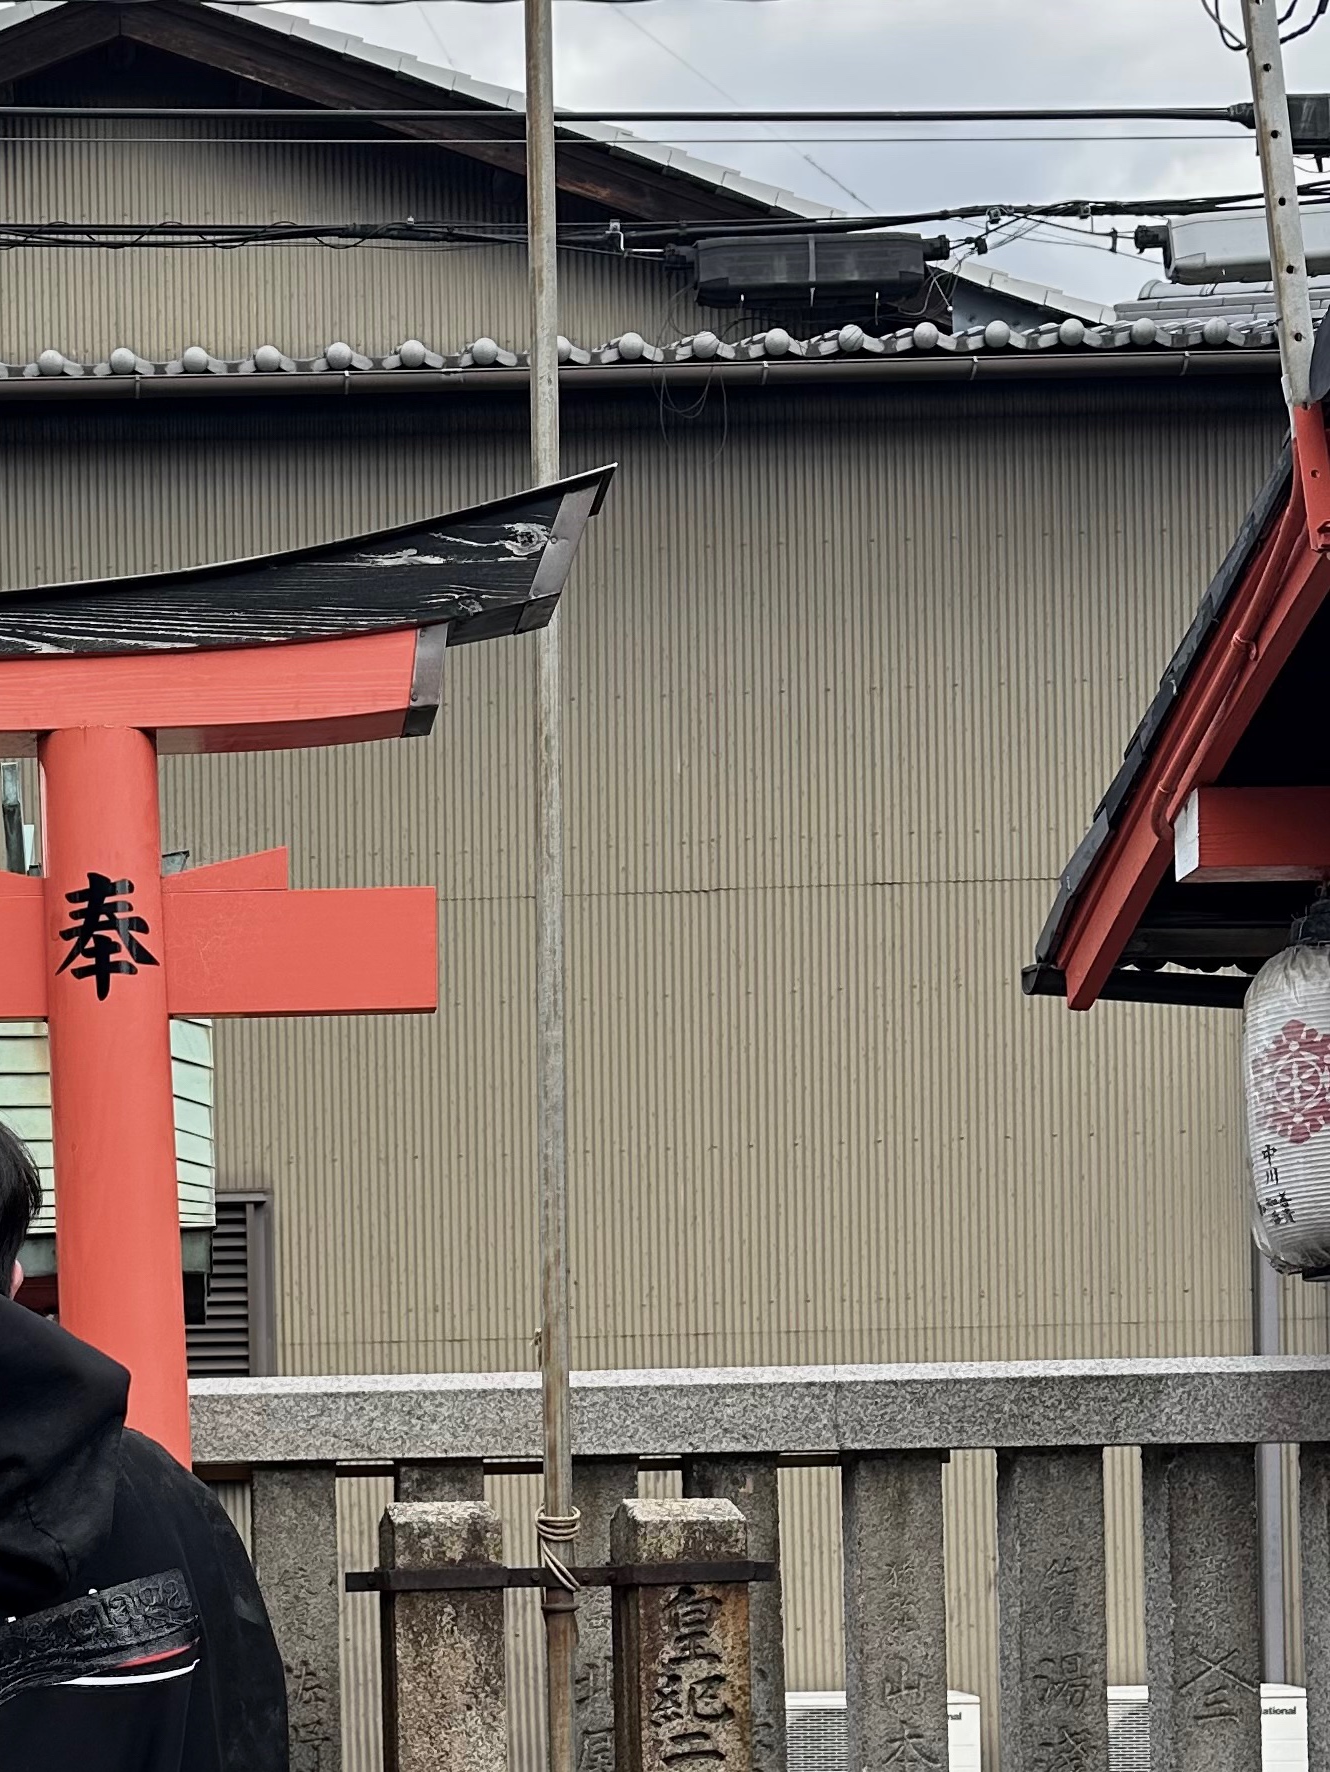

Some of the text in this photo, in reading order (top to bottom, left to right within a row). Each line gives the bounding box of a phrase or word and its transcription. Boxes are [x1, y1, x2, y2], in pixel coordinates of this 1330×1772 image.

[55, 872, 160, 1001] 奉
[1261, 1143, 1279, 1185] 中川
[1261, 1705, 1297, 1715] ational
